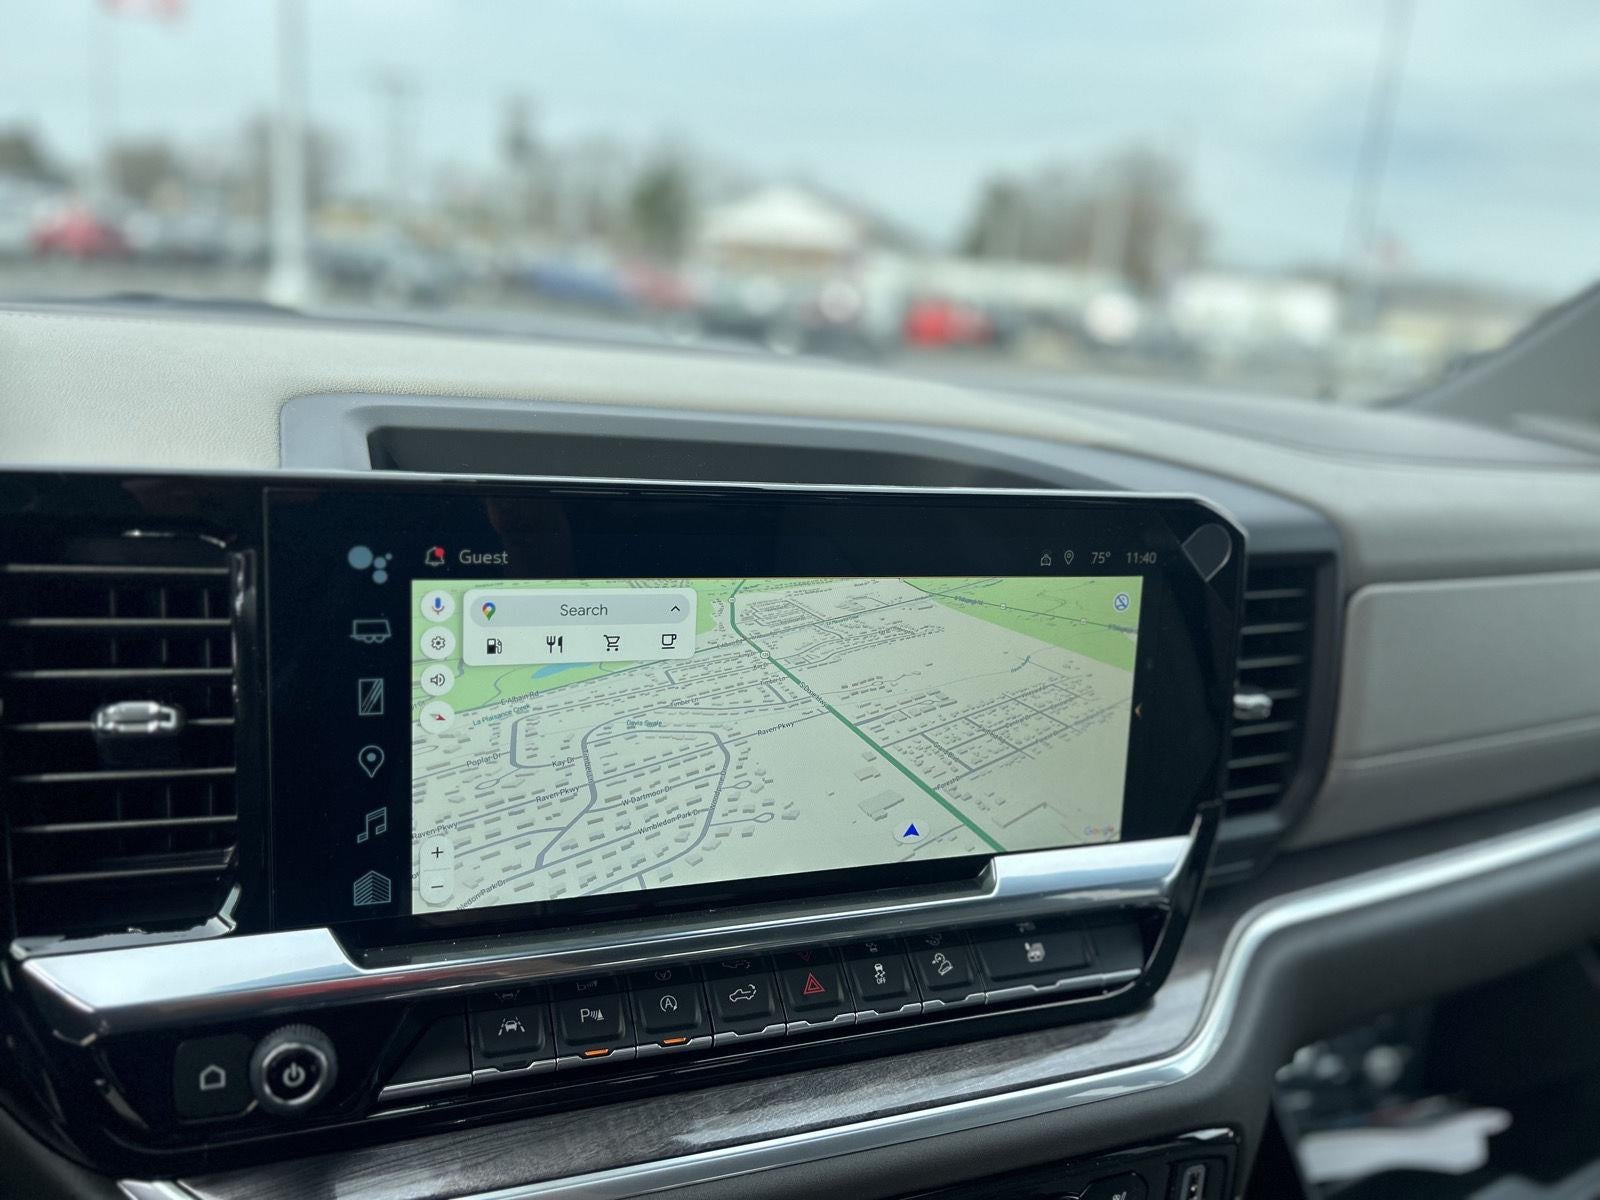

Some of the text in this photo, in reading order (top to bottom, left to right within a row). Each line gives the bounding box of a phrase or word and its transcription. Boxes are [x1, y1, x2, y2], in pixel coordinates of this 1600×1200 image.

[458, 549, 508, 564] Guest
[1091, 551, 1157, 564] 75° 11:40
[560, 603, 608, 616] Search
[529, 690, 539, 698] Rd
[513, 703, 530, 713] Creek
[757, 721, 796, 736] Raven Pkwy
[466, 753, 502, 768] Poplar Dr
[552, 758, 567, 768] Kay
[535, 785, 580, 803] Raven Pkwy
[631, 789, 663, 804] Dartmoor
[664, 785, 673, 793] Dr
[412, 821, 458, 840] Raven Pkwy
[637, 817, 675, 834] Wimbledon
[676, 812, 692, 822] Park
[480, 883, 497, 896] Park
[497, 879, 507, 887] Dr
